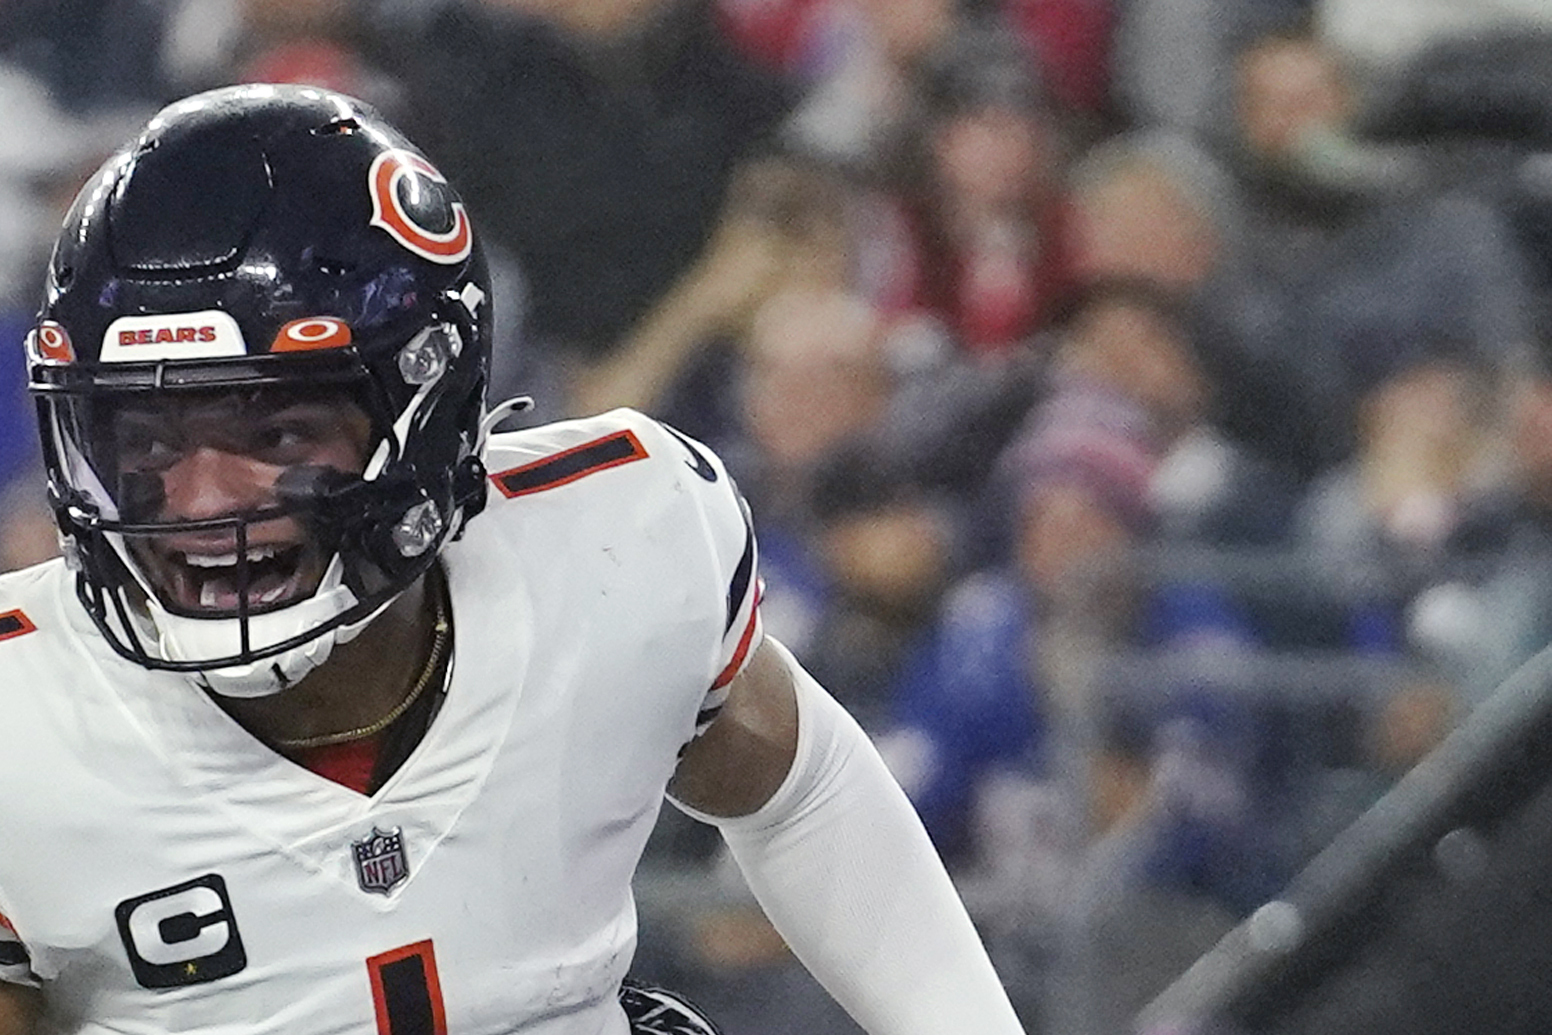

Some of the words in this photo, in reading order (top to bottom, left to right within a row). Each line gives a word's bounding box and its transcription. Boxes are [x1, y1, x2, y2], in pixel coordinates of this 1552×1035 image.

[368, 148, 473, 264] C
[119, 326, 217, 346] BEARS
[488, 429, 650, 499] 1
[364, 855, 403, 884] NFL
[128, 886, 230, 966] C
